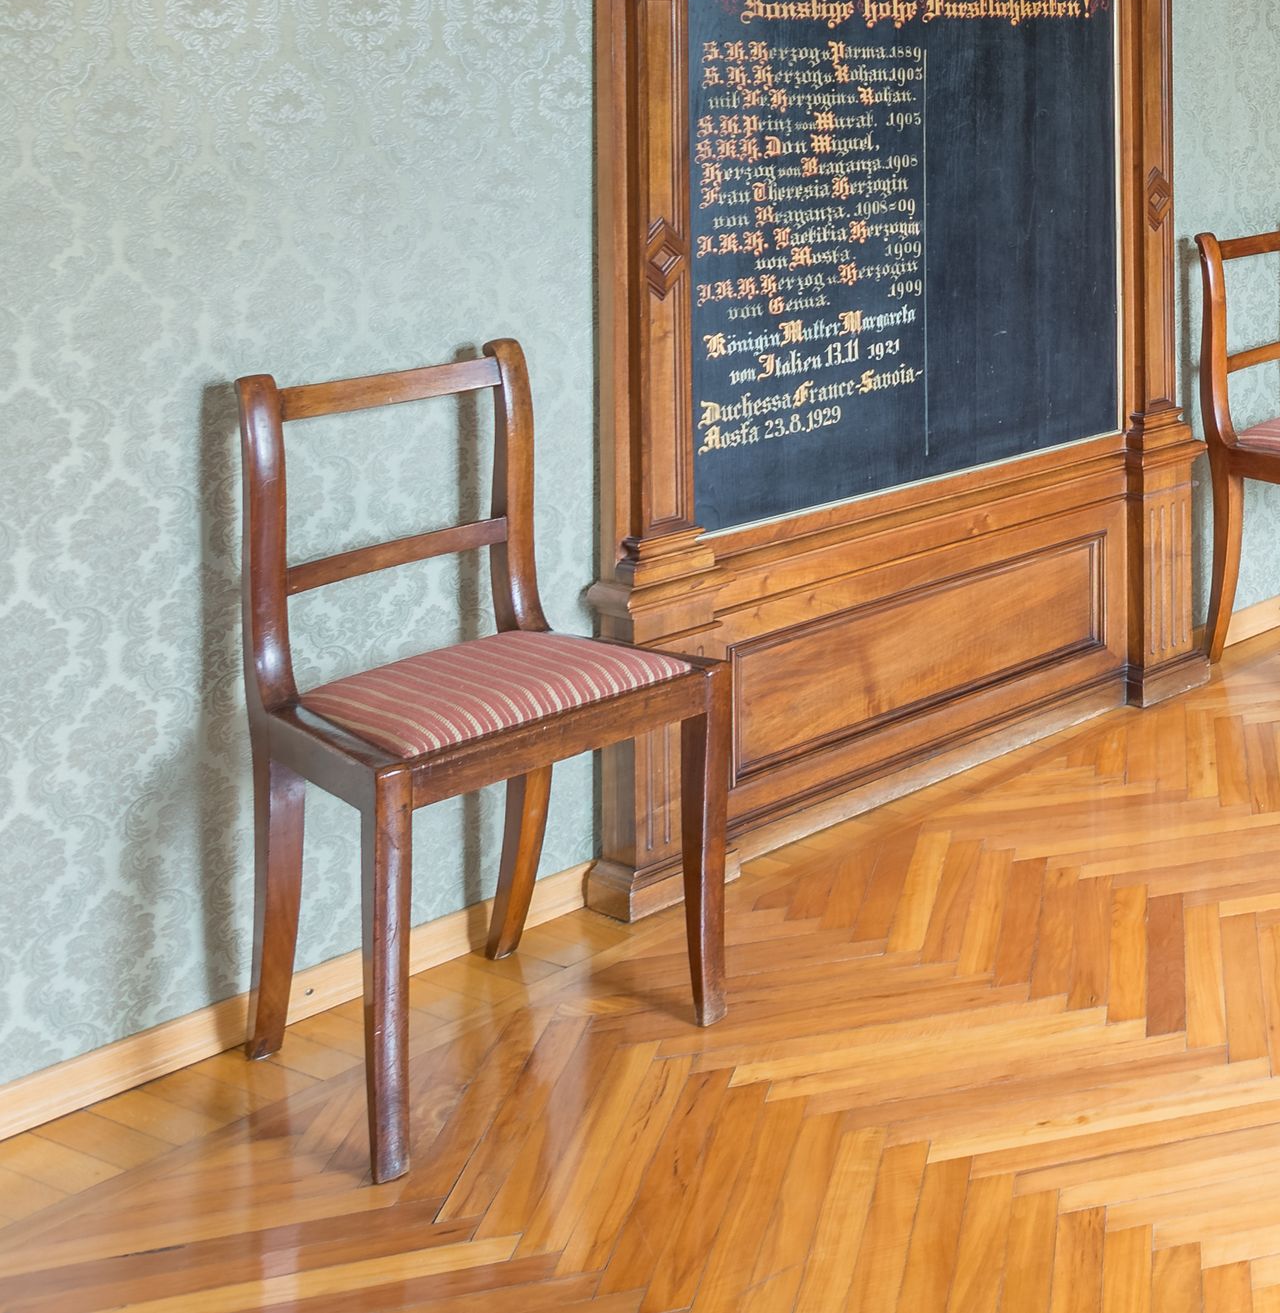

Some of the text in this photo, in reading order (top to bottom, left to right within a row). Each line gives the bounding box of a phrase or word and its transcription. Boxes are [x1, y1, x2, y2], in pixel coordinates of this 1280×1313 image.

[748, 40, 821, 68] Herzog
[889, 46, 921, 62] 1889
[752, 65, 824, 90] Herzog
[708, 91, 741, 110] mit
[769, 88, 847, 115] Herzogin
[857, 86, 917, 108] Rohan.
[742, 115, 792, 138] Prinz
[793, 122, 817, 132] von
[814, 110, 878, 132] Murat.
[763, 135, 808, 158] Don
[810, 131, 881, 156] Miguel,
[700, 163, 777, 186] Herzog
[777, 168, 801, 178] von
[884, 155, 919, 173] 1908
[700, 174, 910, 209] Frau Theresia Herzogin
[712, 215, 750, 230] von
[754, 206, 851, 228] Braganza.
[847, 217, 921, 243] Herzogin
[754, 257, 789, 271] von
[884, 241, 922, 260] 1909
[759, 271, 826, 299] Herzog
[837, 259, 920, 286] Herzogin
[726, 279, 923, 320] von Genua. 1909
[703, 304, 917, 360] Königin Mutter Margareta
[728, 367, 757, 385] von
[757, 349, 824, 382] Italien
[866, 338, 901, 361] 1921
[698, 392, 793, 430] Duchessa
[698, 418, 761, 455] Aosta
